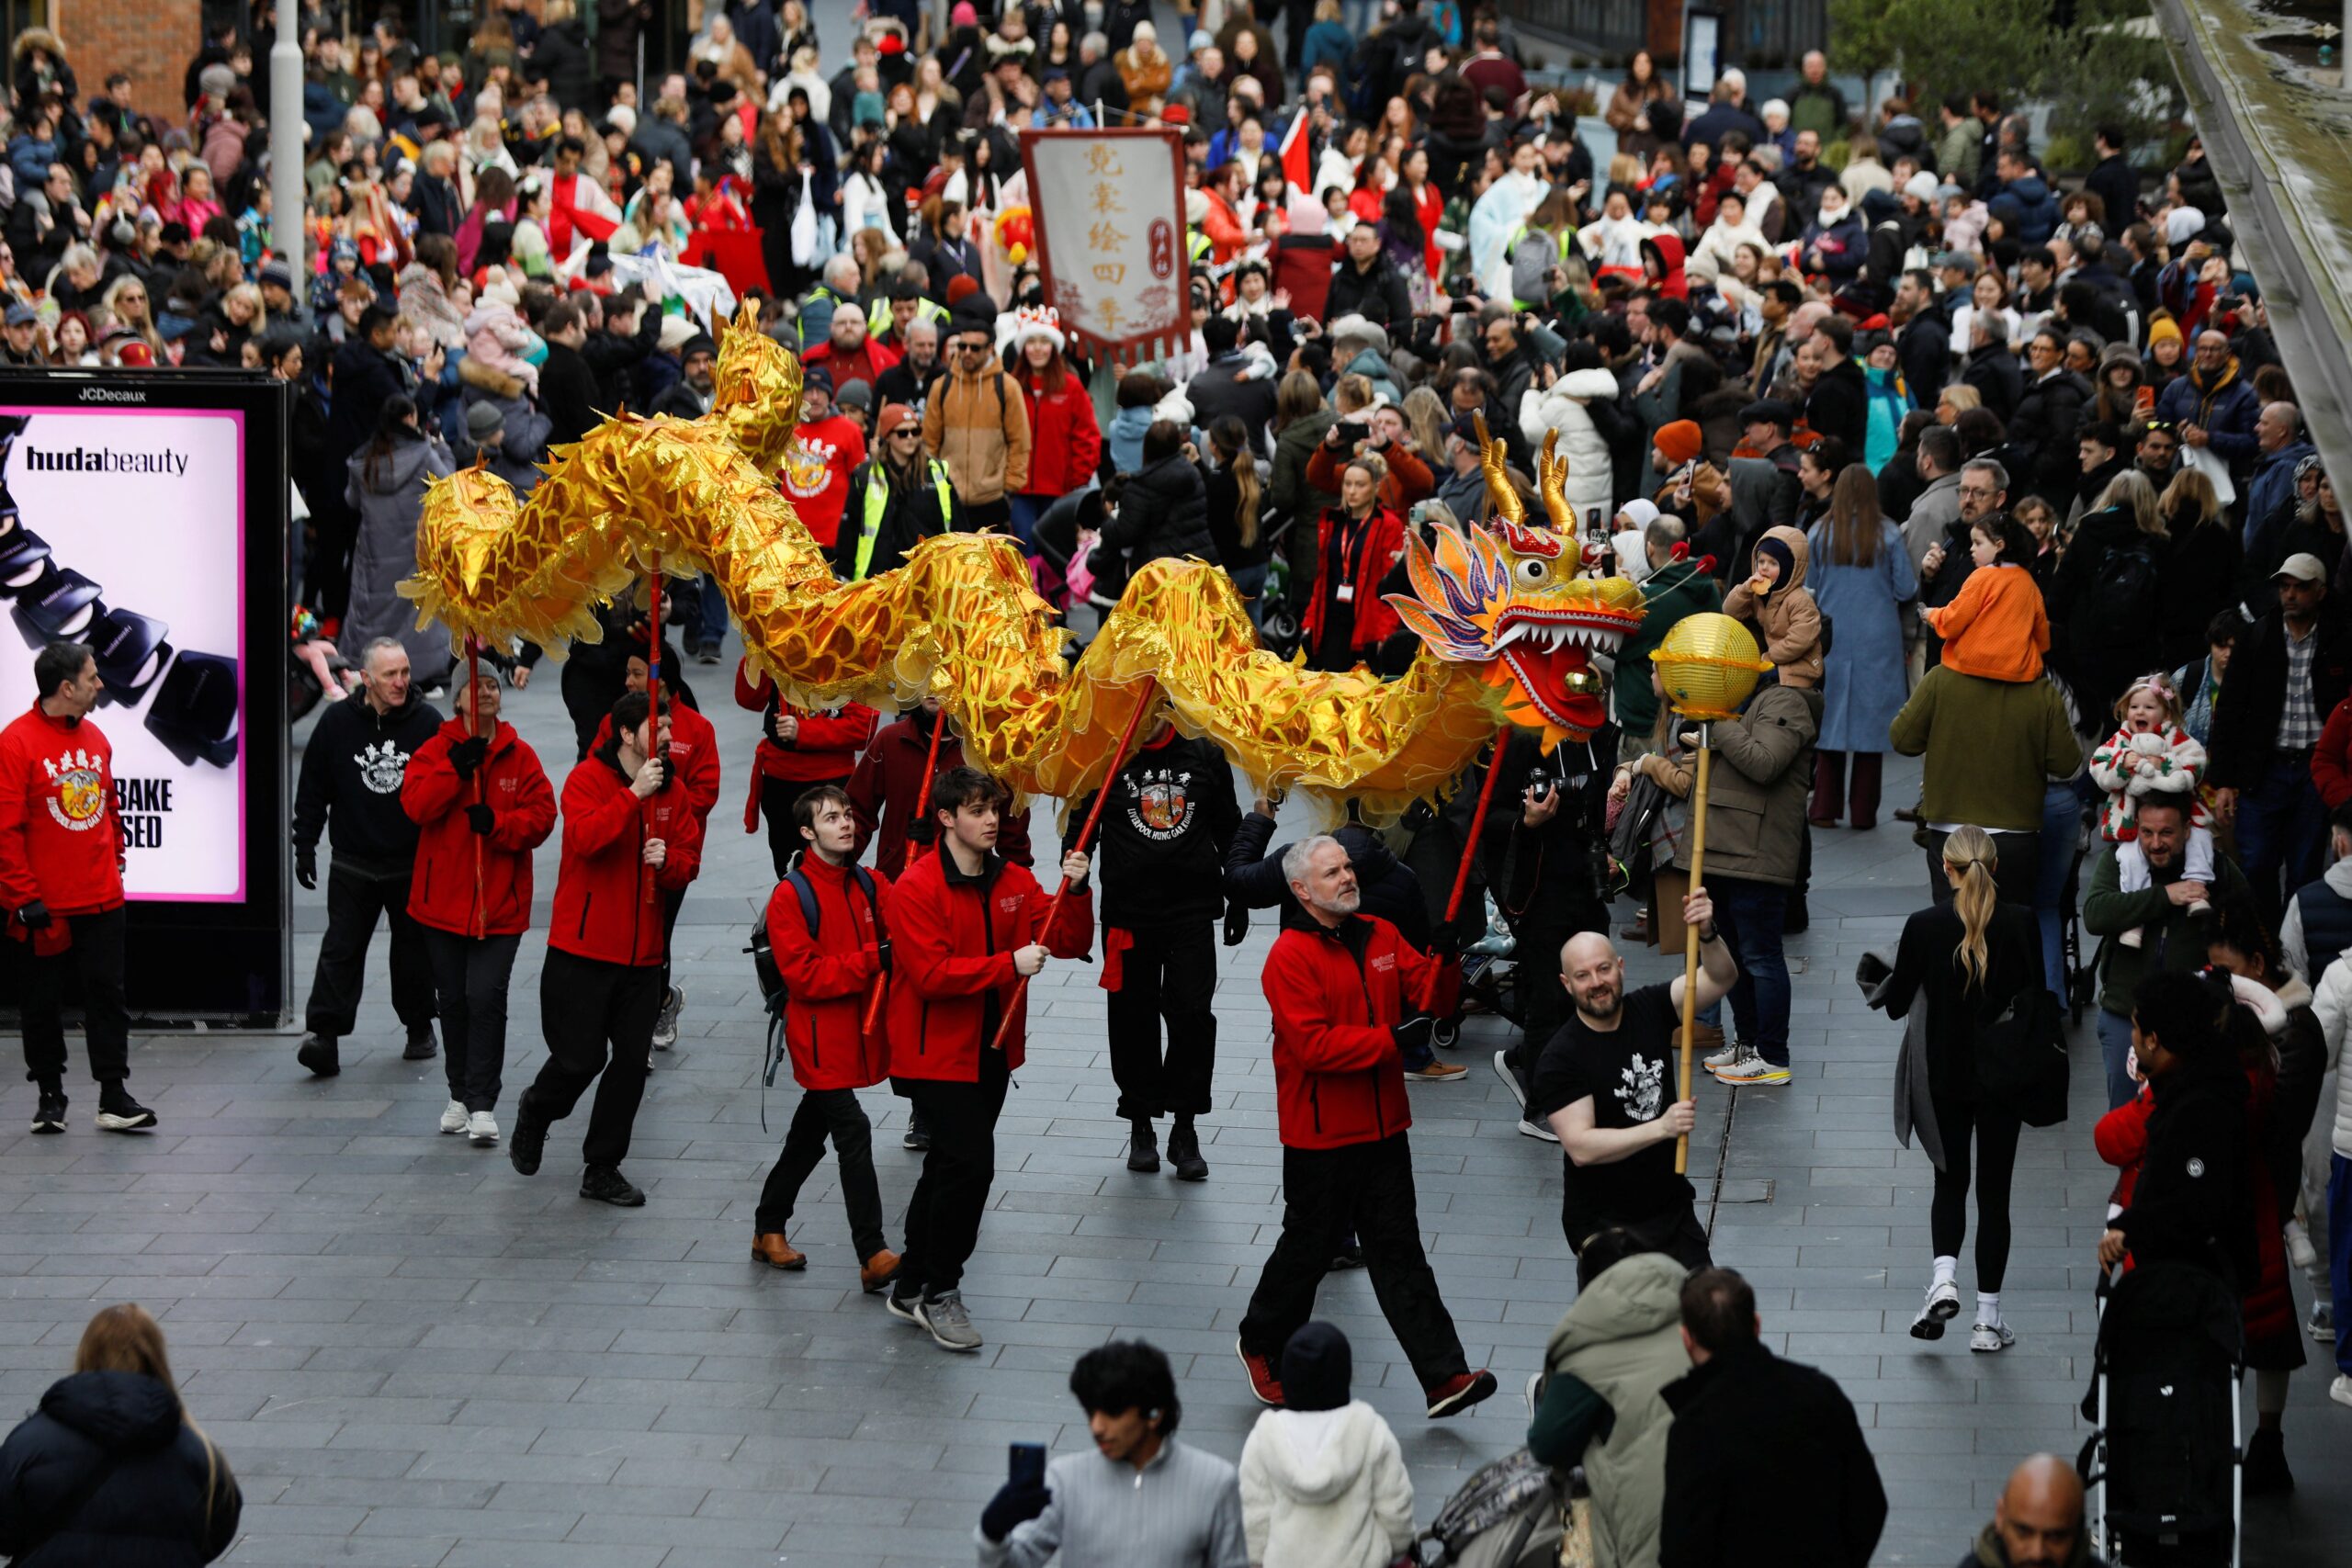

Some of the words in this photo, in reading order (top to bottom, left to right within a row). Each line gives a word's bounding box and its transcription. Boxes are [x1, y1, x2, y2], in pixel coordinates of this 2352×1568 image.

[78, 387, 146, 401] JCDecaux
[27, 446, 188, 478] hudabeauty
[1186, 802, 1195, 810] FU
[1127, 808, 1152, 838] LIVERPOOL
[1181, 811, 1193, 830] KUNG
[119, 816, 162, 848] SED
[1151, 830, 1171, 840] HUNG
[1170, 825, 1185, 838] GAR
